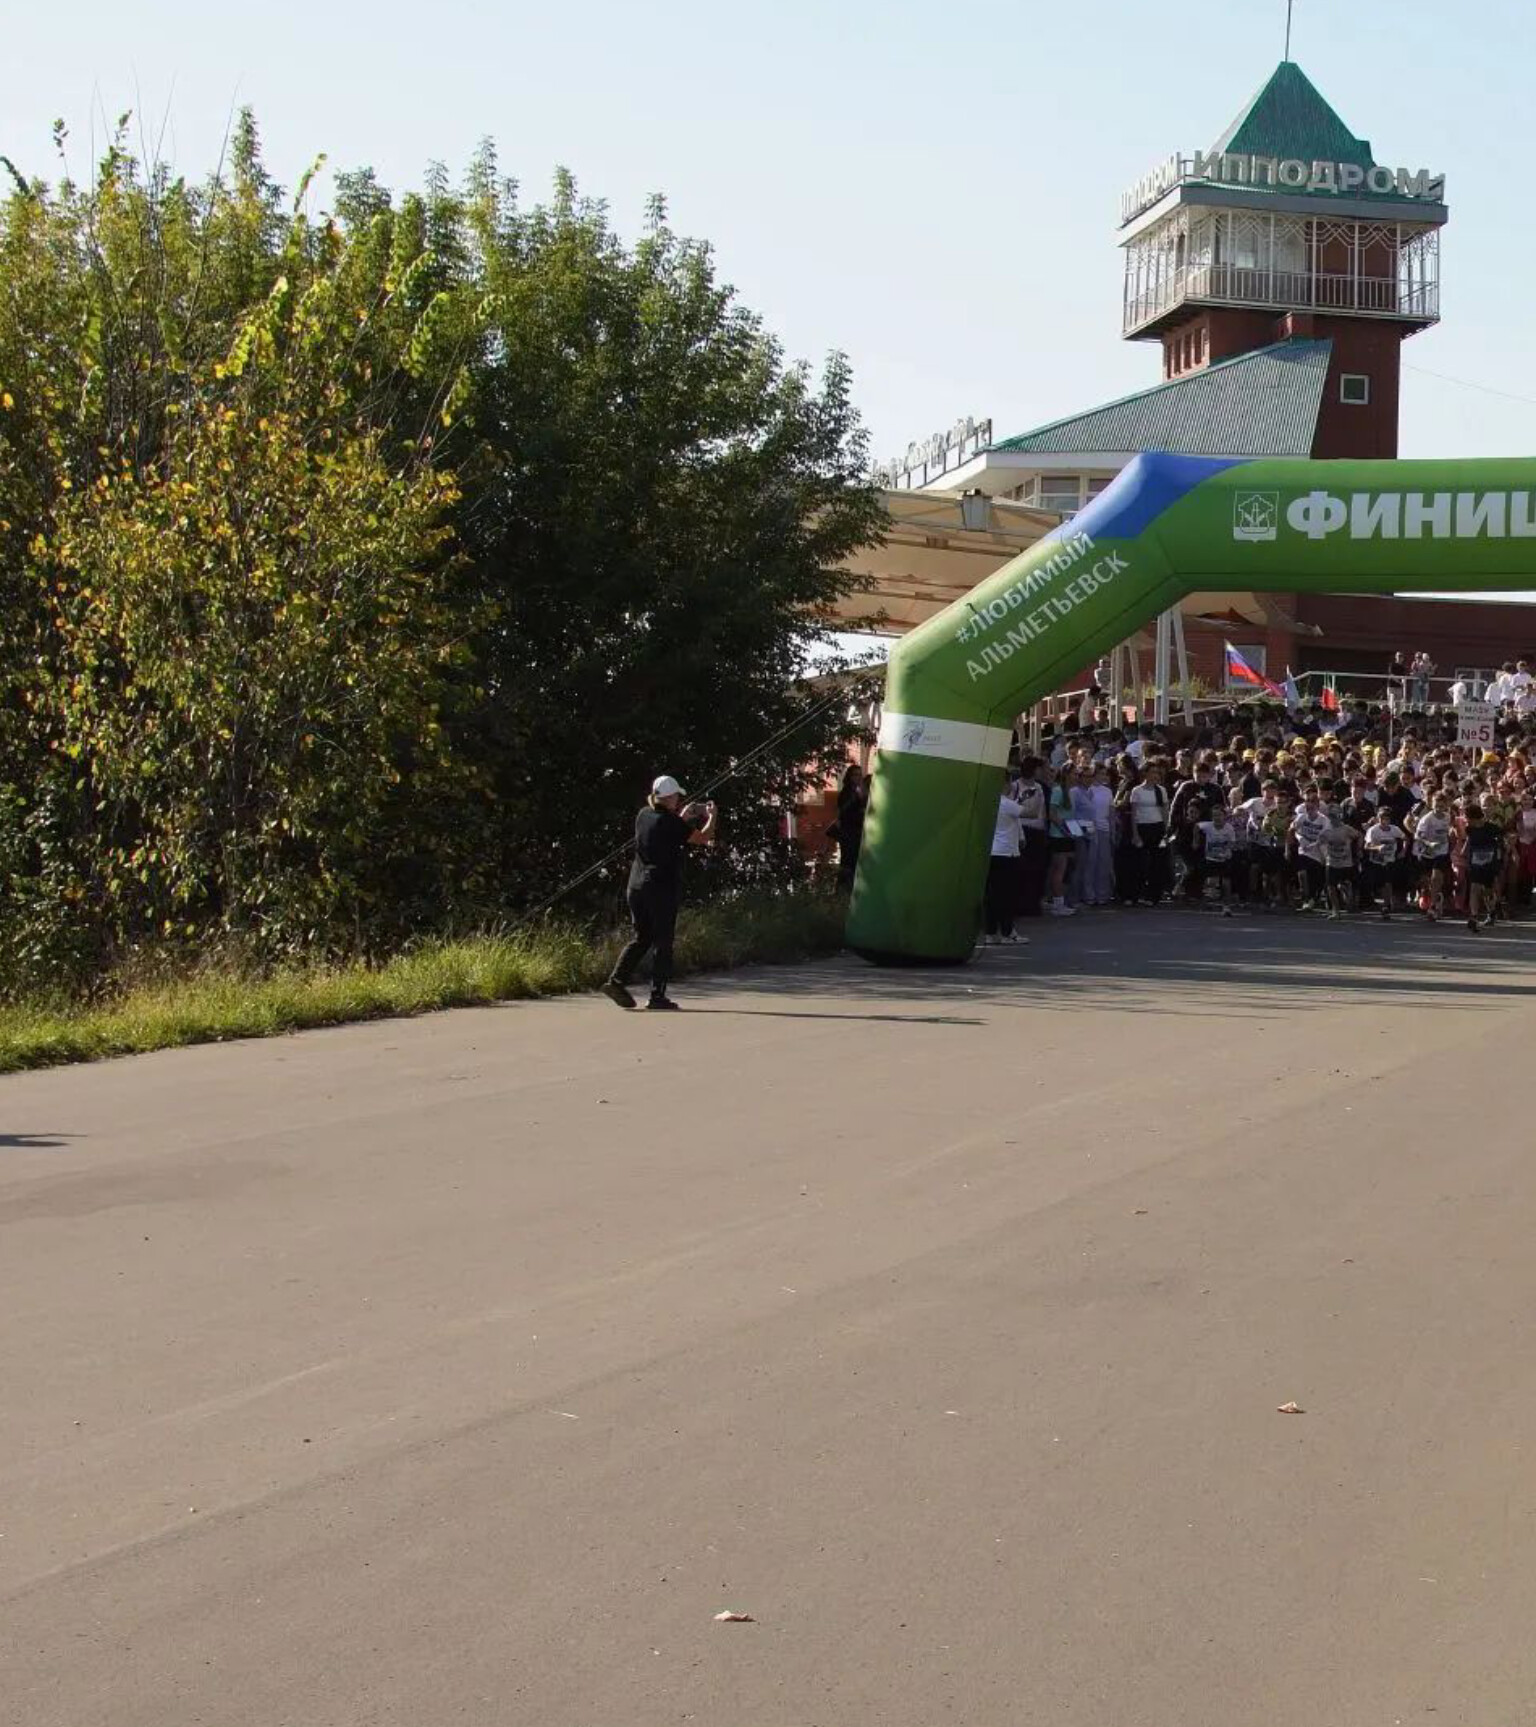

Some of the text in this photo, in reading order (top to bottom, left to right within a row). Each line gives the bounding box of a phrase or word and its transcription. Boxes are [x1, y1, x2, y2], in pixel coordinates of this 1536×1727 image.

[1194, 149, 1429, 197] ИППОДРОМ
[955, 531, 1095, 644] #ЛЮБИМЫЙ
[965, 550, 1130, 682] АЛЬМЕТЬЕВСК
